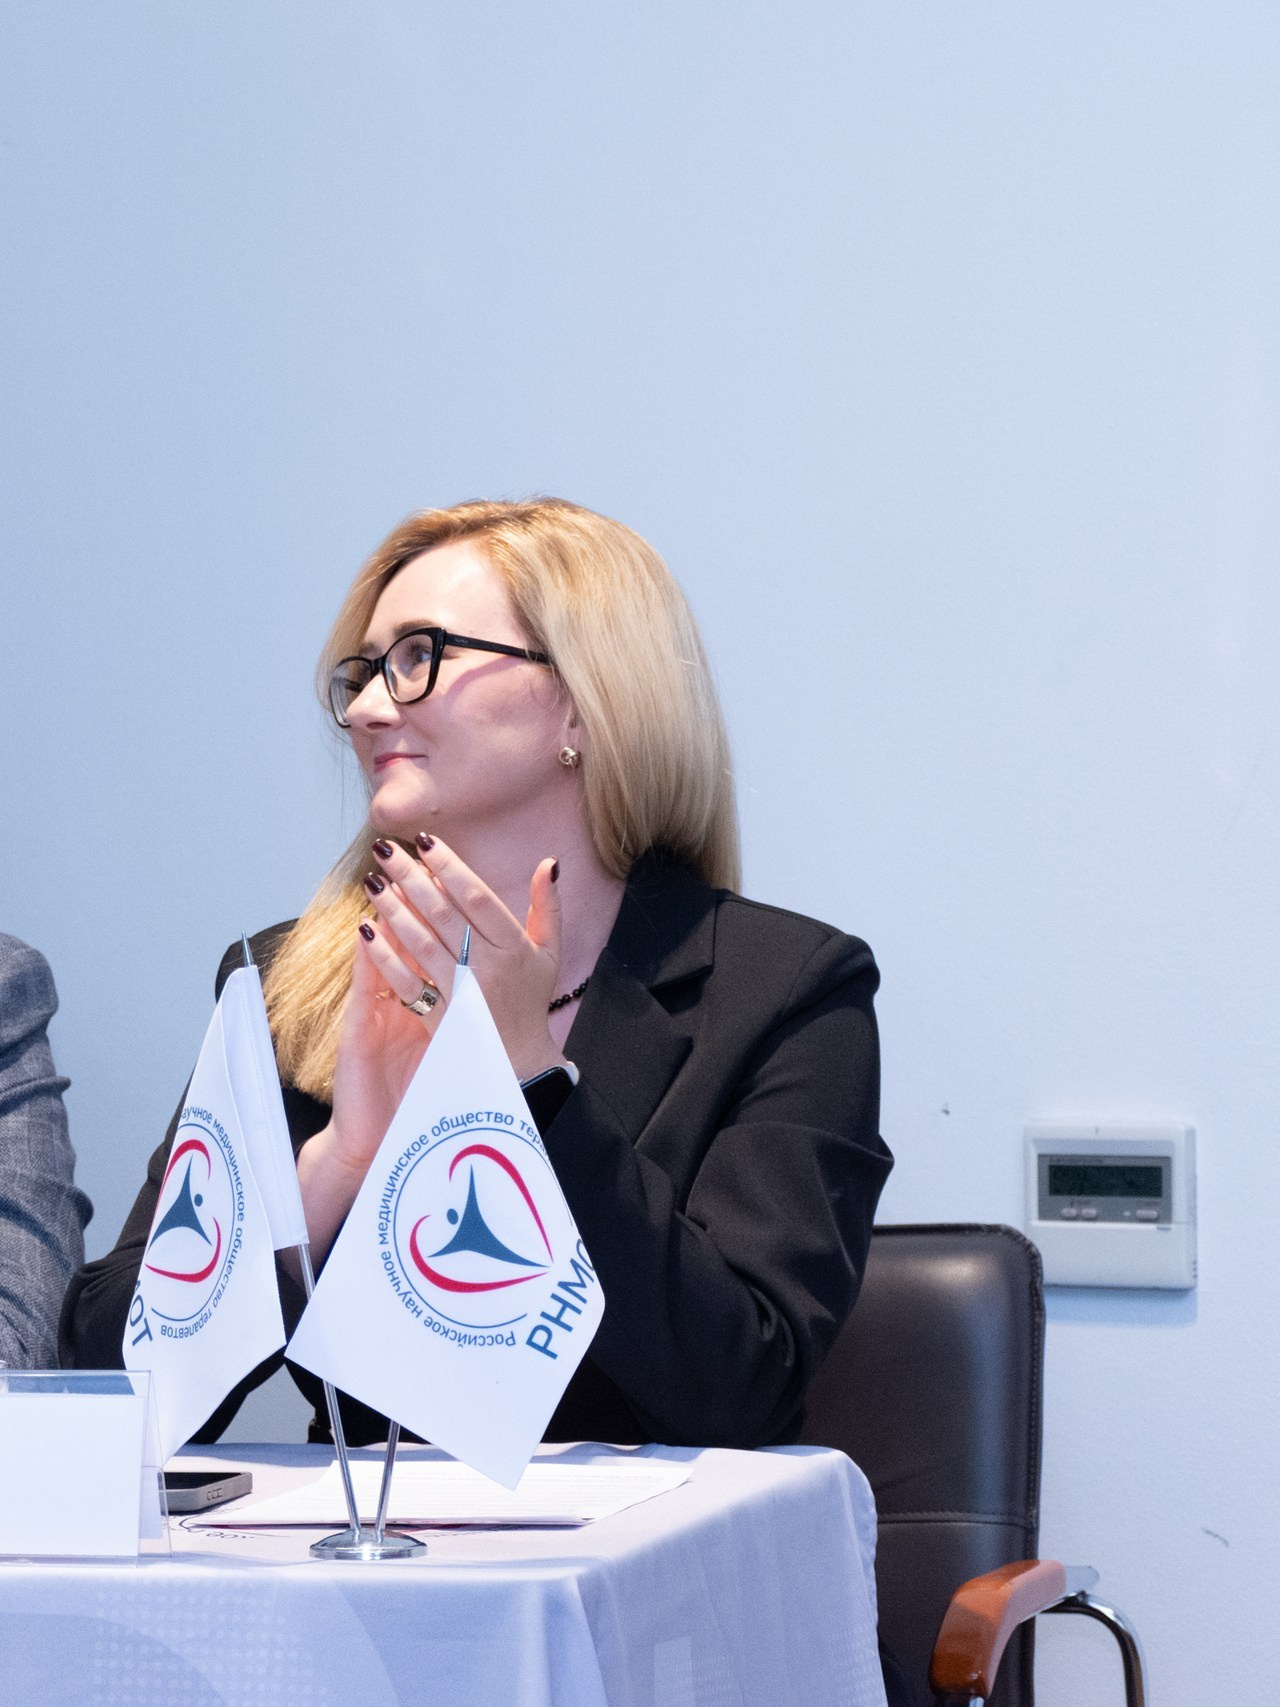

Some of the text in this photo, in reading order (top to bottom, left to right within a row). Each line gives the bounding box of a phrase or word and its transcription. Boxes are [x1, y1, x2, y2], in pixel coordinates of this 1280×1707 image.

[431, 1111, 514, 1137] общество
[213, 1118, 244, 1221] медицинское
[378, 1134, 429, 1244] медицинское
[212, 1226, 243, 1308] общество
[381, 1251, 423, 1318] научное
[130, 1280, 153, 1346] ОТ
[161, 1311, 212, 1339] терапевтов
[424, 1316, 516, 1348] Российское
